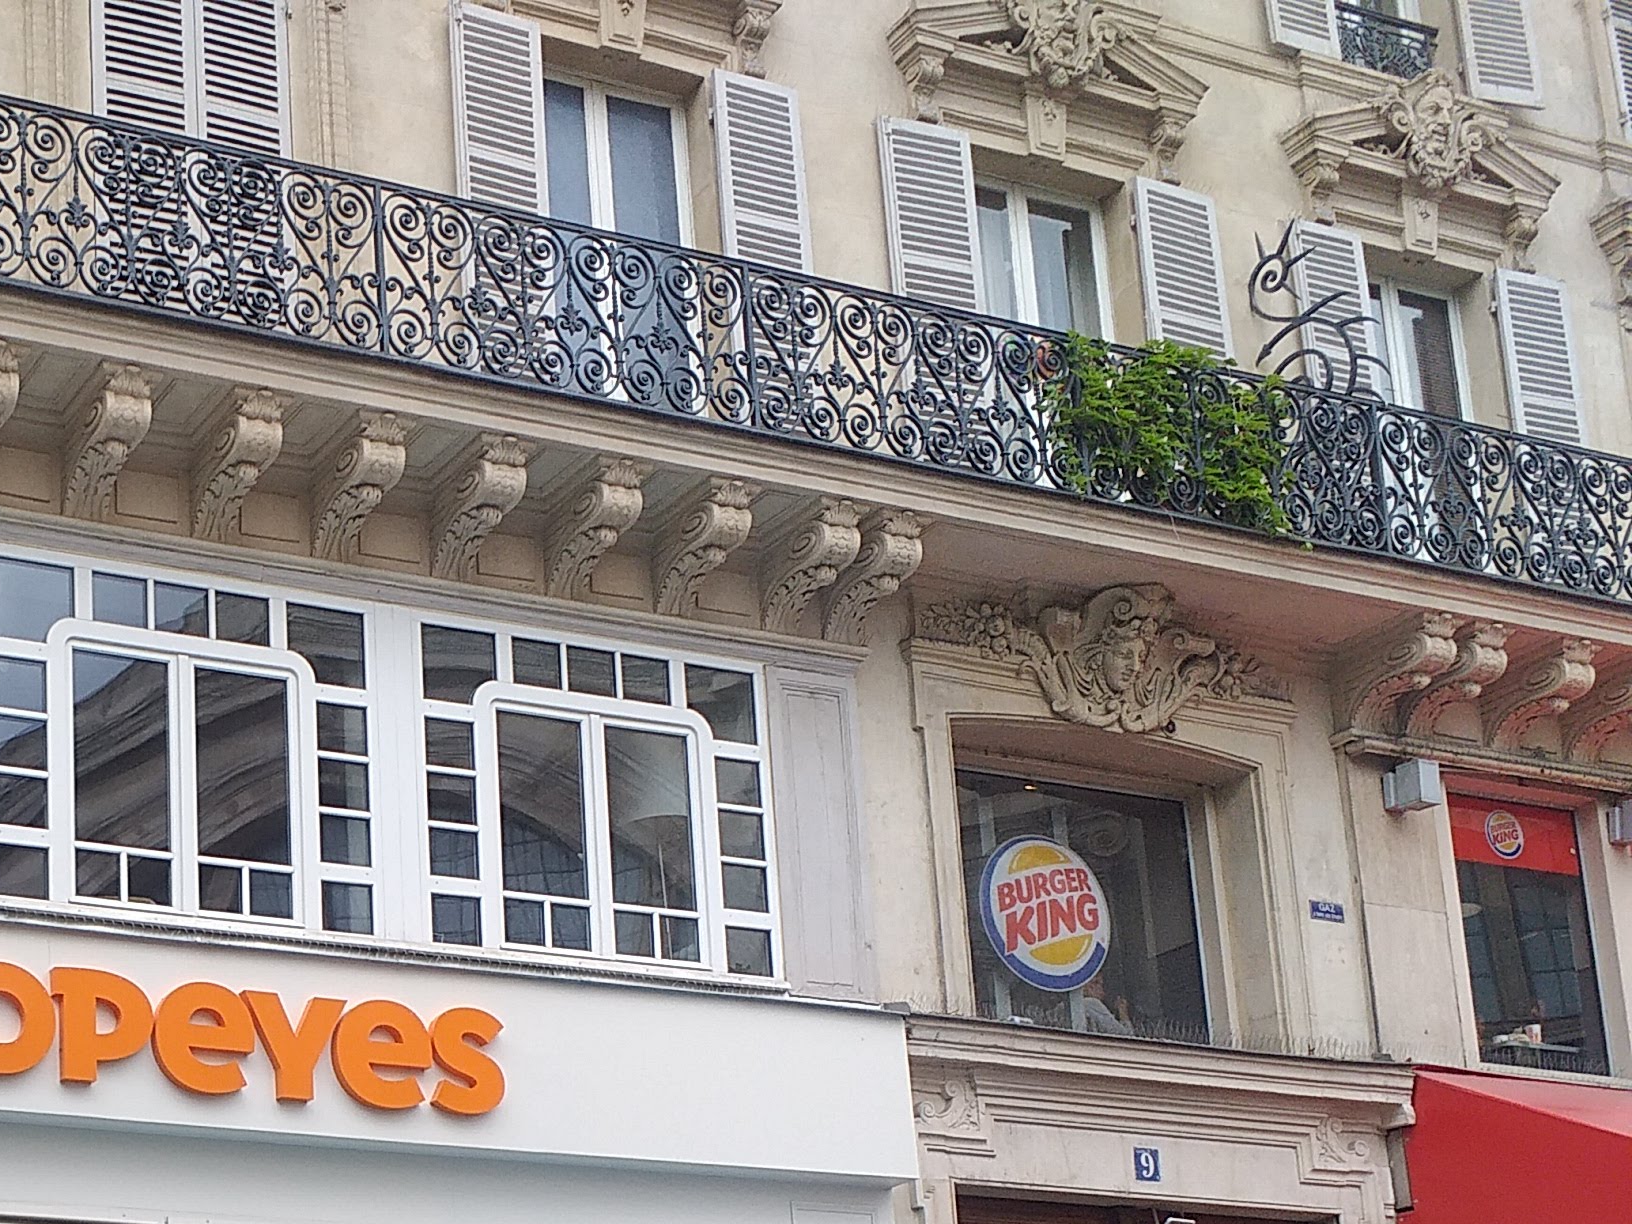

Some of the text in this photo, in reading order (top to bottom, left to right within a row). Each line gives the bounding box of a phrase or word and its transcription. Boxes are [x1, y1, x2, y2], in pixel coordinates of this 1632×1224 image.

[1493, 829, 1519, 845] KING
[997, 868, 1092, 913] BURGER
[1318, 903, 1336, 913] GAZ
[1005, 892, 1100, 953] KING
[1140, 1152, 1155, 1178] 9
